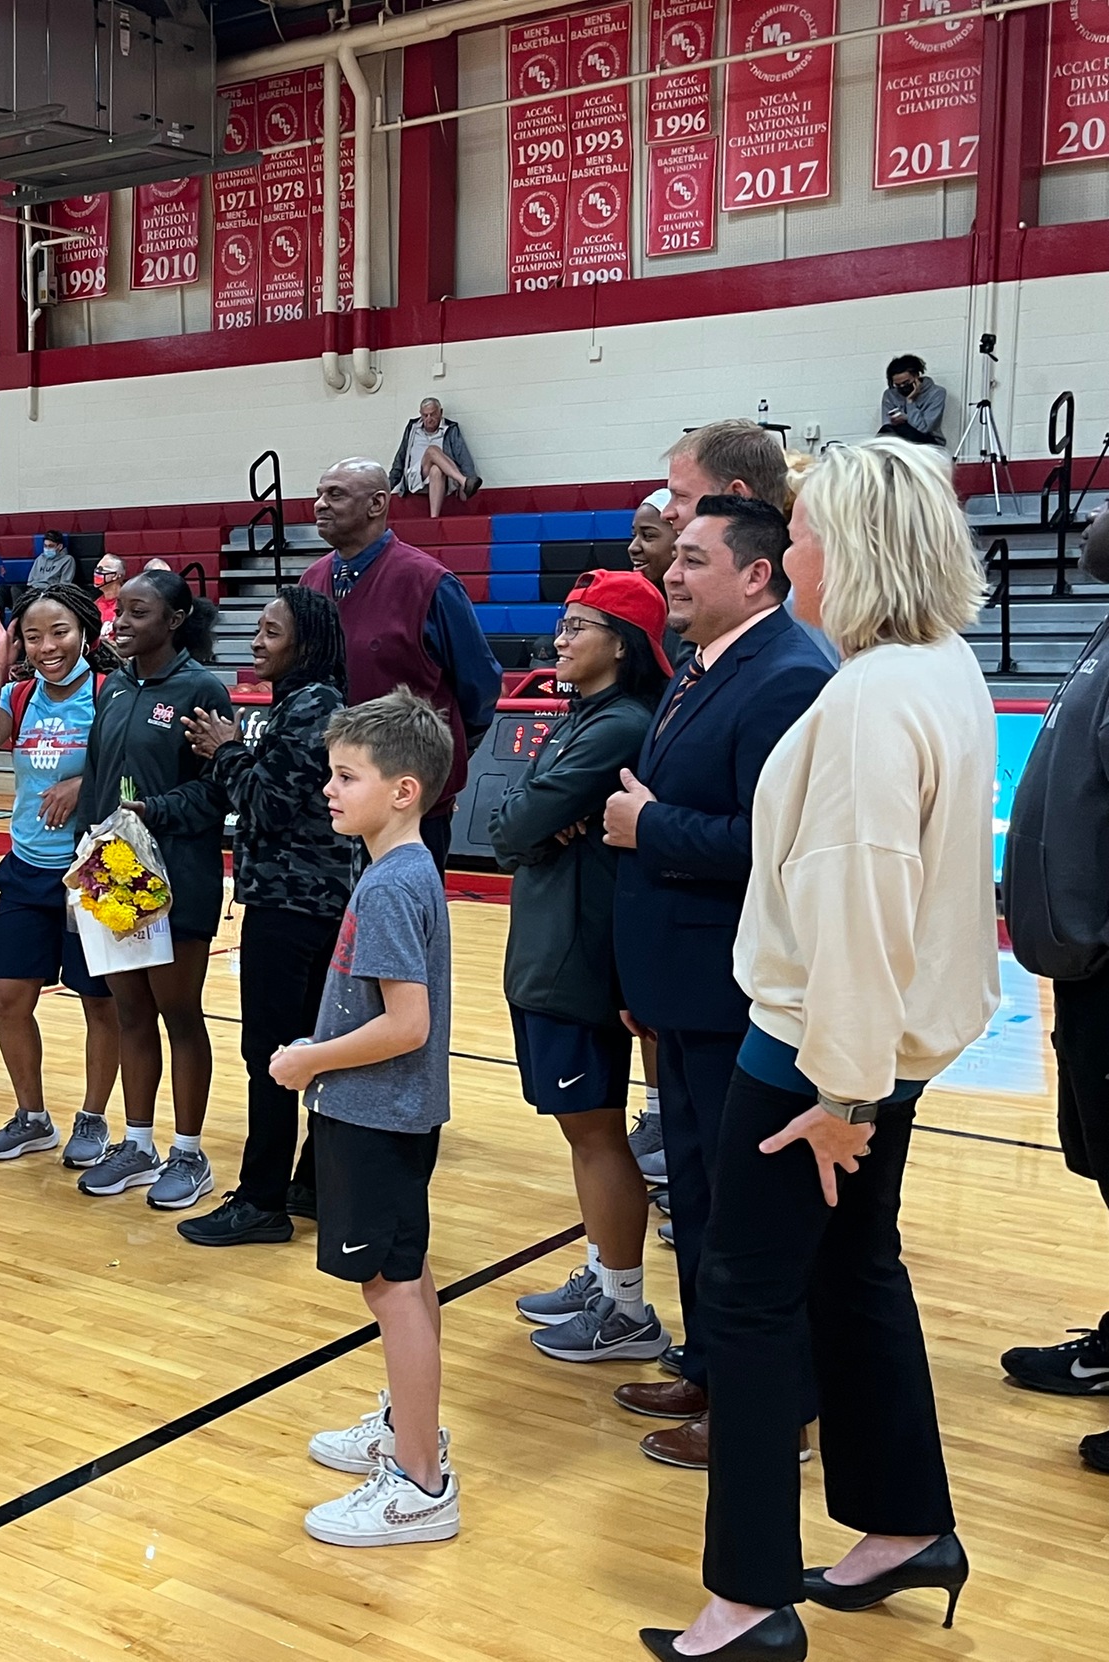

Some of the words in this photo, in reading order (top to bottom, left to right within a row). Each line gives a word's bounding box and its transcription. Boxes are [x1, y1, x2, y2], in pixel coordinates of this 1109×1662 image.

[653, 1, 714, 20] BASKETBALL
[584, 13, 611, 26] MEN'S
[524, 26, 550, 40] MEN'S
[570, 21, 627, 41] BASKETBALL
[512, 34, 566, 53] BASKETBALL
[886, 74, 922, 91] ACCAC
[928, 64, 981, 84] REGION
[1053, 60, 1101, 79] ACCAC
[268, 78, 290, 90] MEN'S
[666, 74, 698, 89] ACCAC
[258, 86, 303, 102] BASKETBALL
[655, 85, 700, 100] DIVISION
[760, 91, 797, 106] NJCAA
[900, 81, 962, 102] DIVISION
[583, 94, 614, 107] ACCAC
[651, 93, 709, 112] CHAMPIONS
[896, 93, 977, 116] CHAMPIONS
[525, 106, 554, 118] ACCAC
[575, 104, 616, 120] DIVISION
[746, 103, 795, 122] DIVISION
[517, 115, 556, 131] DIVISION
[572, 113, 627, 131] CHAMPIONS
[654, 110, 706, 138] 1996
[748, 114, 808, 133] NATIONAL
[513, 123, 567, 141] CHAMPIONS
[728, 123, 827, 148] CHAMPIONSHIPS
[575, 129, 624, 156] 1993
[670, 145, 695, 155] MEN'S
[740, 142, 775, 159] SIXTH
[777, 137, 814, 154] PLACE
[517, 139, 564, 166] 1990
[586, 154, 612, 166] MEN'S
[657, 152, 709, 167] BASKETBALL
[888, 136, 980, 178] 2017
[265, 158, 297, 171] DIVISION
[527, 164, 552, 176] MEN'S
[572, 162, 628, 179] BASKETBALL
[262, 166, 306, 181] CHAMPIONS
[513, 172, 567, 188] BASKETBALL
[734, 160, 820, 202] 2017
[266, 181, 305, 203] 1978
[153, 202, 185, 216] NJCAA
[219, 191, 256, 212] 1971
[274, 202, 295, 212] MEN'S
[143, 214, 189, 230] DIVISION
[226, 210, 247, 220] MEN'S
[263, 208, 307, 223] BASKETBALL
[663, 211, 693, 222] REGION
[216, 217, 259, 231] BASKETBALL
[658, 220, 704, 232] CHAMPIONS
[146, 226, 187, 241] REGION
[582, 233, 614, 245] ACCAC
[661, 231, 700, 250] 2015
[138, 236, 199, 254] CHAMPIONS
[523, 242, 552, 253] ACCAC
[573, 243, 616, 255] DIVISION
[56, 246, 109, 264] CHAMPIONS
[515, 251, 554, 263] DIVISION
[568, 252, 627, 266] CHAMPIONS
[140, 252, 196, 283] 2010
[511, 260, 563, 274] CHAMPIONS
[61, 266, 106, 296] 1998
[273, 272, 297, 281] ACCAC
[571, 267, 623, 287] 1999
[225, 280, 247, 290] ACCAC
[266, 281, 298, 292] DIVISION
[215, 296, 255, 308] CHAMPIONS
[218, 289, 250, 300] DIVISION
[262, 289, 305, 301] CHAMPIONS
[218, 310, 252, 330] 1985
[265, 302, 303, 324] 1986
